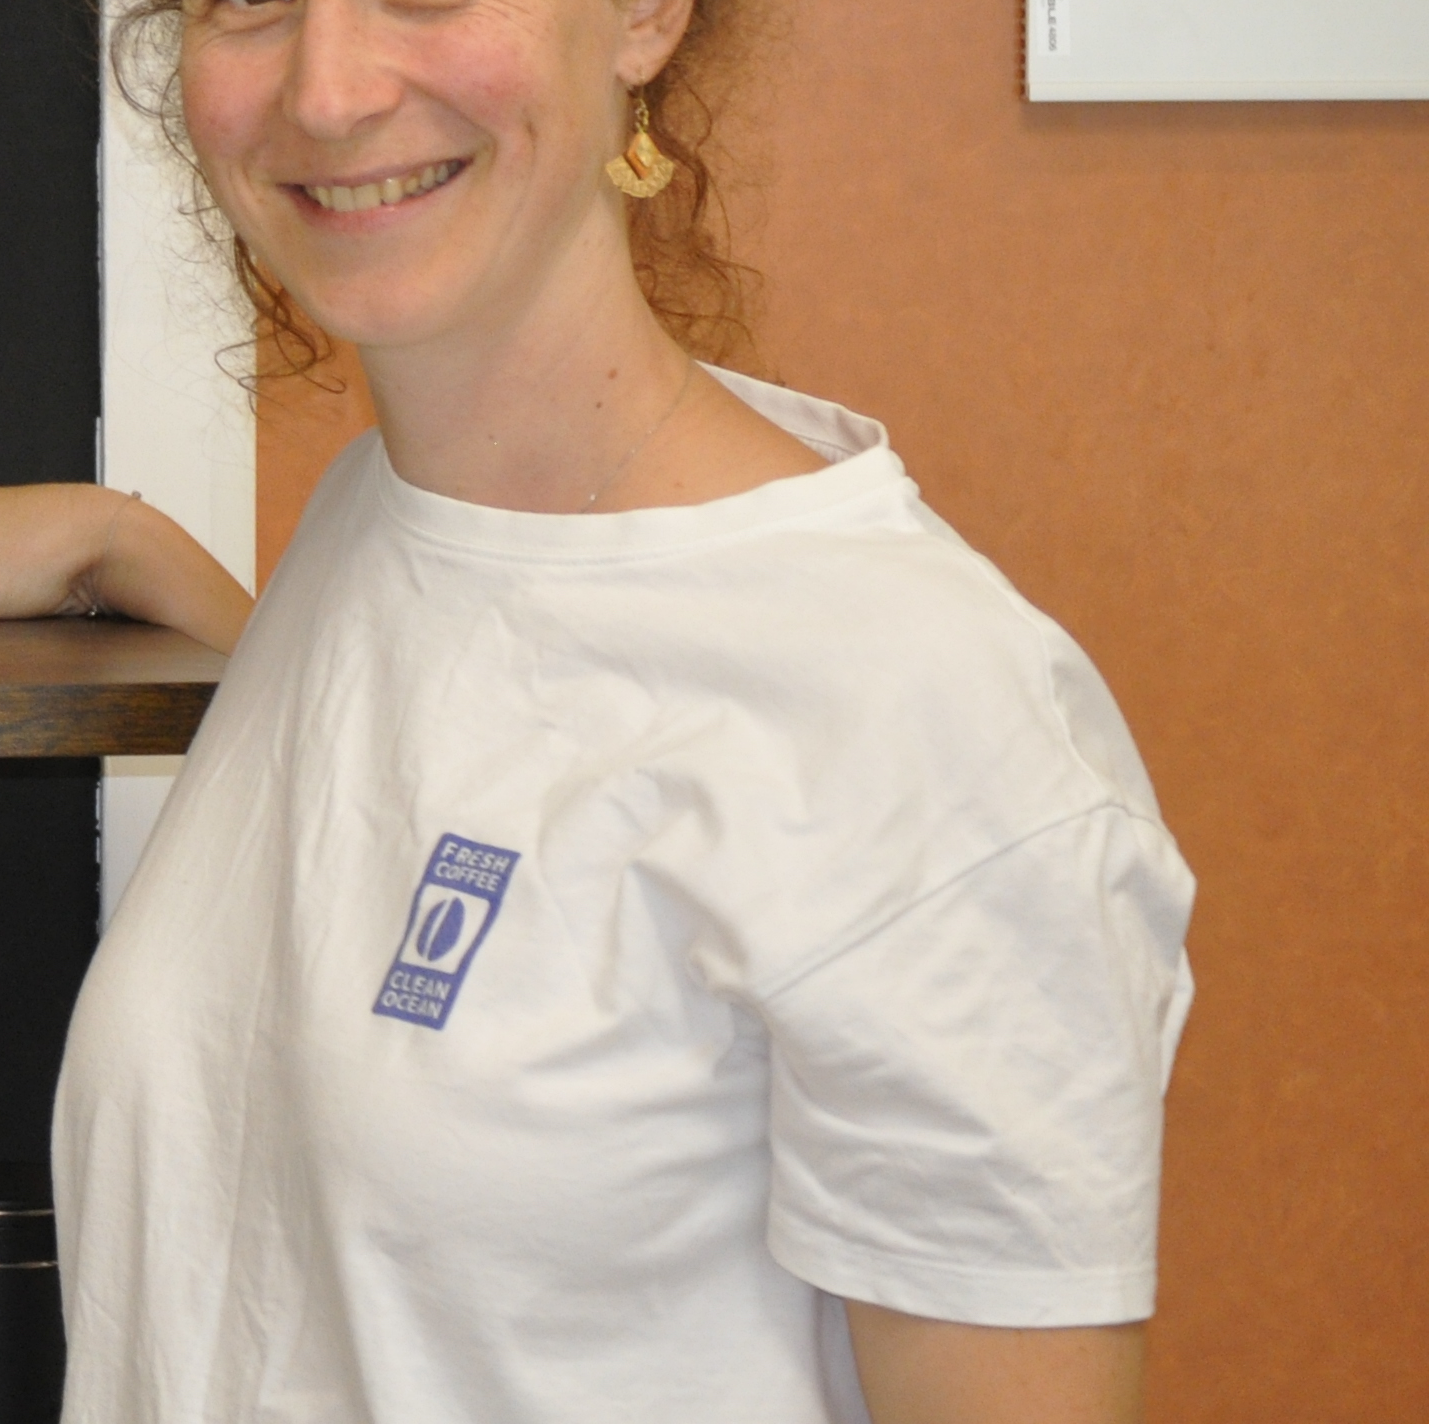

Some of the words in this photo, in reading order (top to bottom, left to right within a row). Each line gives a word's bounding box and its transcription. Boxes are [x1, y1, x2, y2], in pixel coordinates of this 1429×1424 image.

[441, 841, 510, 873] FRESH
[434, 861, 502, 893] COFFEE
[389, 969, 452, 1000] CLEAN
[381, 990, 443, 1019] OCEAN
